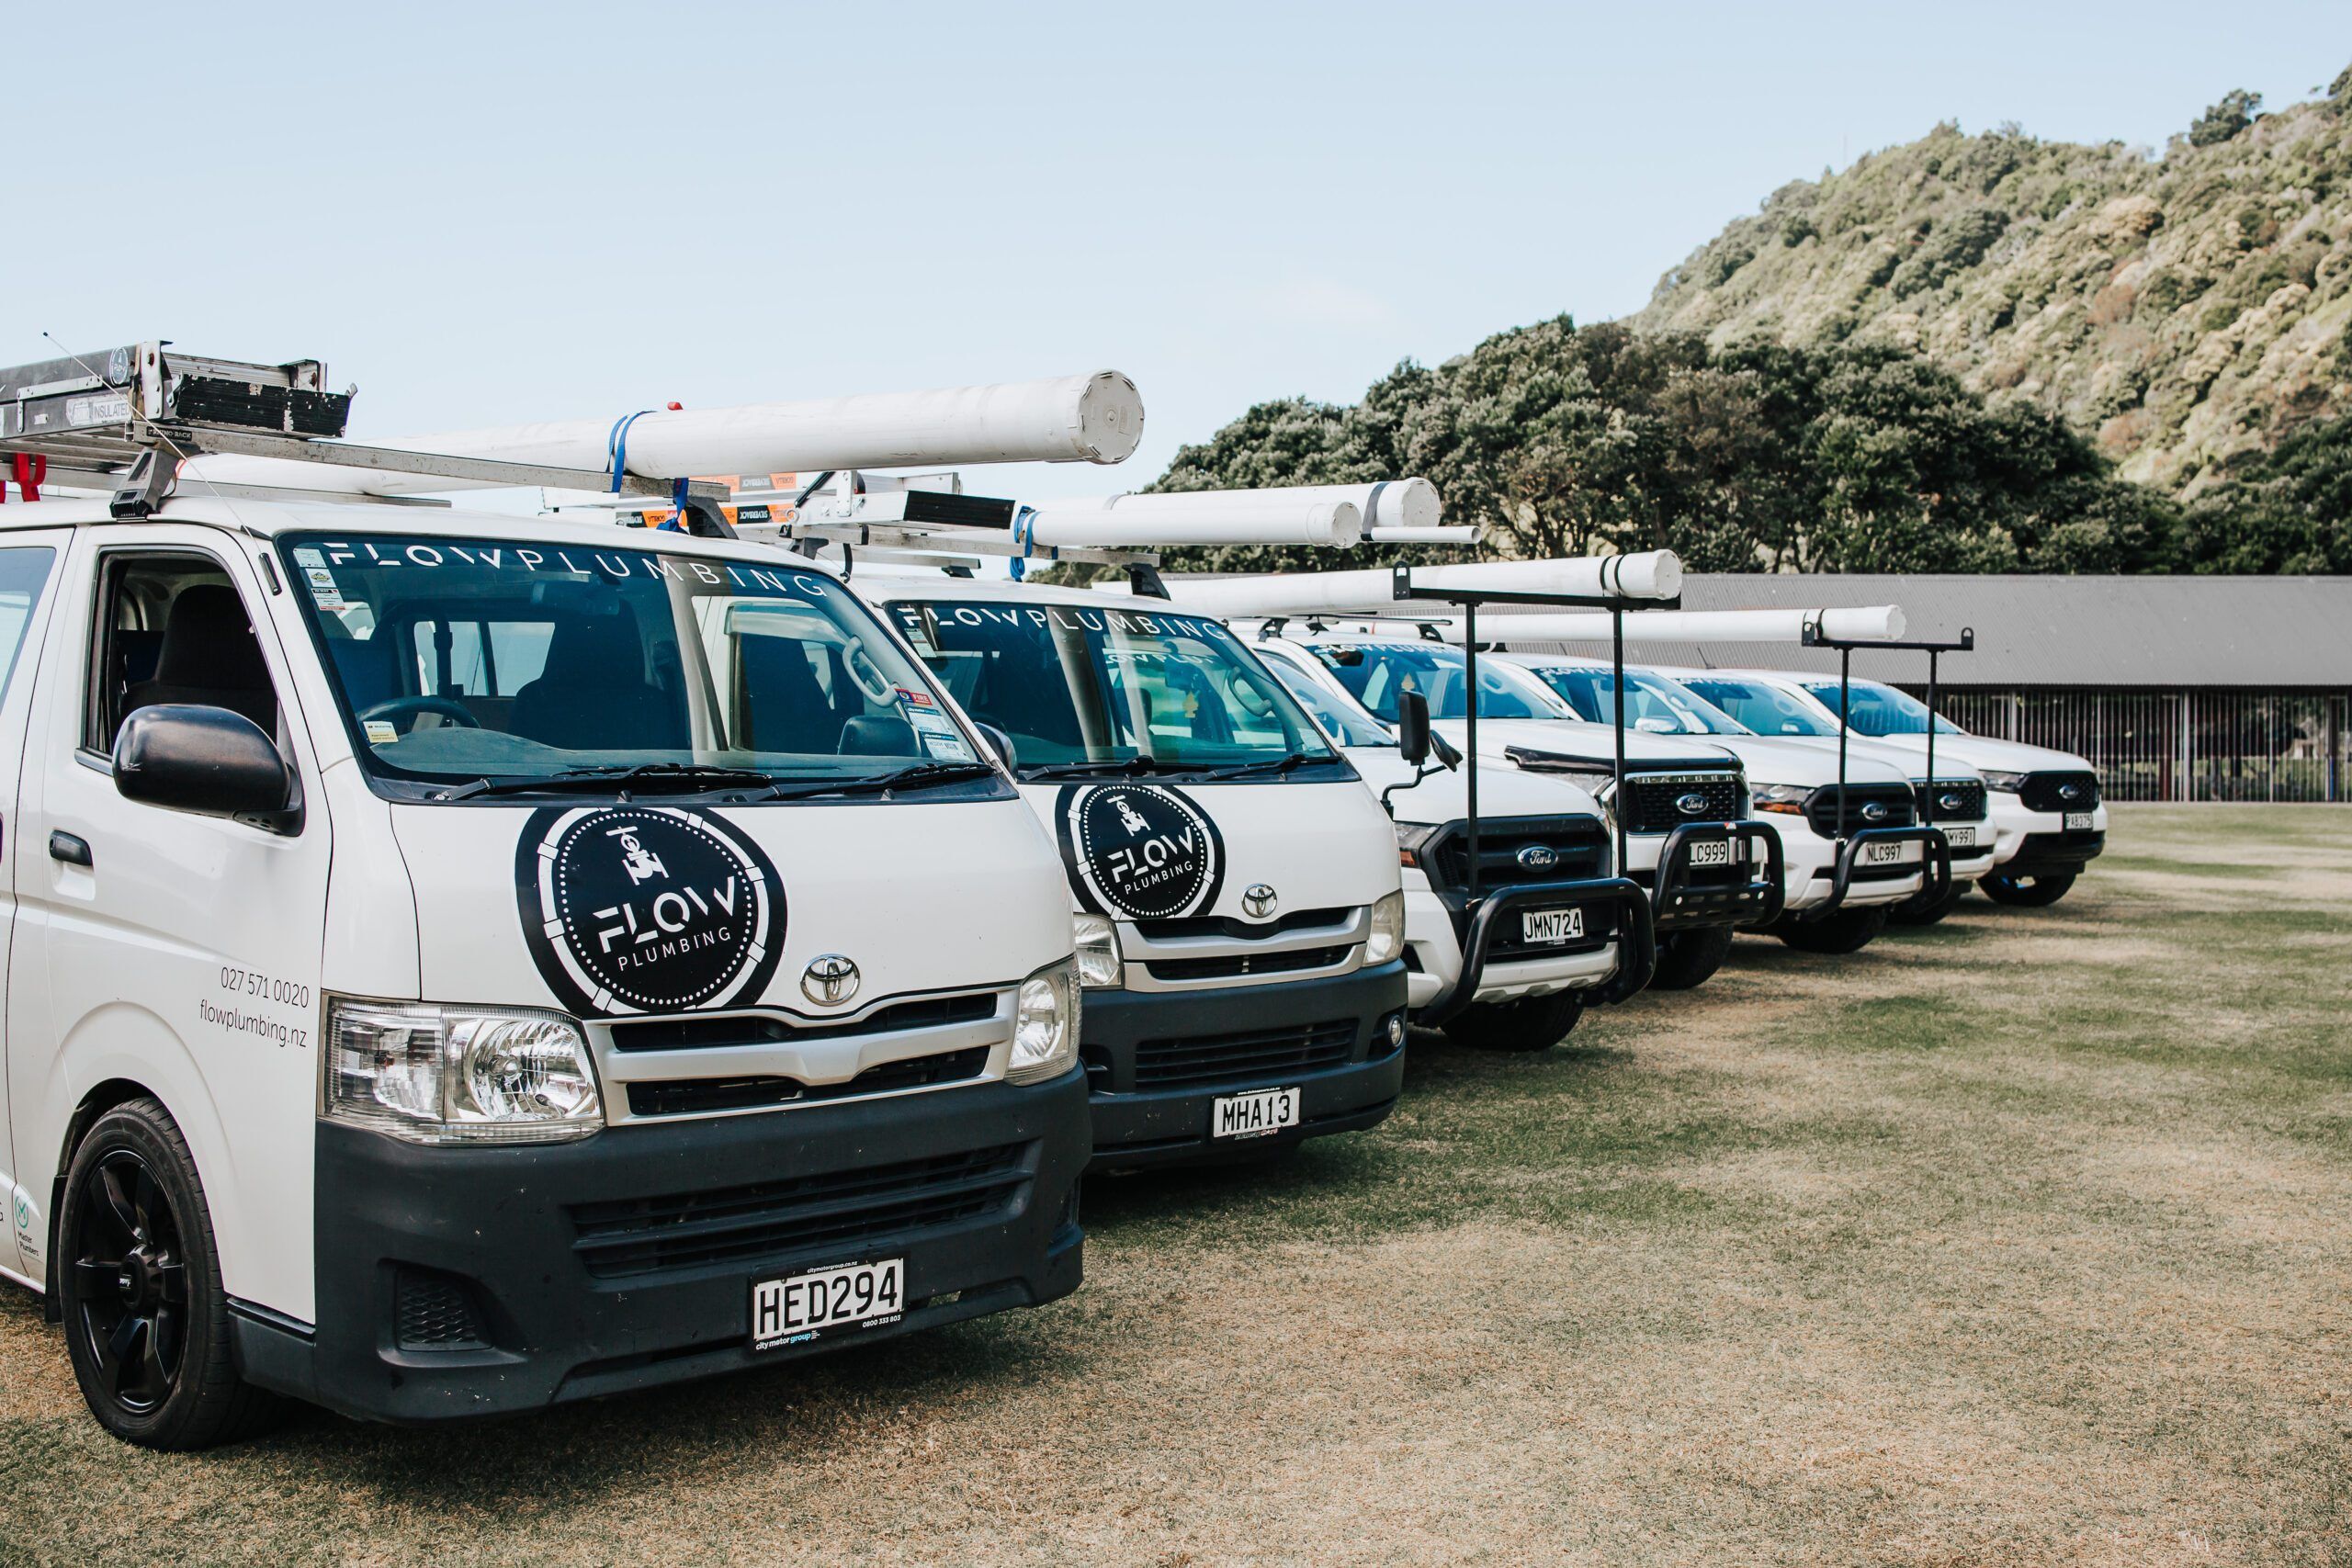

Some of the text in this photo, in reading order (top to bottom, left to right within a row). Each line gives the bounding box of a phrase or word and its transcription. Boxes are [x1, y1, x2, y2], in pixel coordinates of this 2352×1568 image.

[740, 510, 768, 520] SILVERBACK
[1947, 829, 1973, 844] MY991
[1107, 826, 1193, 884] FLOW
[1690, 843, 1726, 863] LC999
[1867, 844, 1902, 863] NLC997
[1124, 861, 1193, 895] PLUMBING
[593, 875, 735, 953] FLOW
[1524, 911, 1581, 940] JMN724
[617, 926, 731, 972] PLUMBING
[220, 966, 310, 1009] 027 571 0020
[199, 998, 307, 1048] flowplumbing.nz
[1222, 1094, 1291, 1133] MHA13
[807, 1260, 858, 1274] citymotorgroup.co.nz
[759, 1266, 898, 1335] HED294
[862, 1314, 901, 1328] 0800 333 803
[755, 1338, 769, 1350] city
[769, 1335, 790, 1348] motor
[790, 1332, 811, 1344] group
